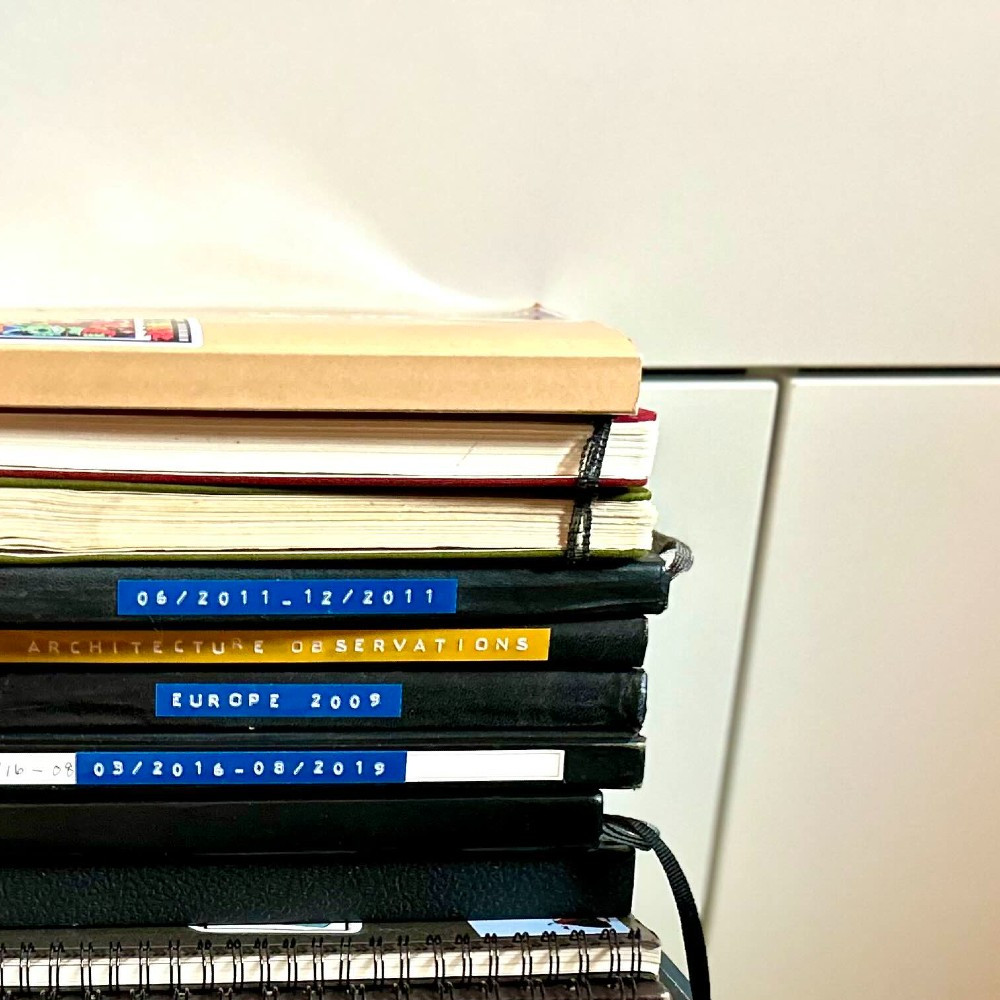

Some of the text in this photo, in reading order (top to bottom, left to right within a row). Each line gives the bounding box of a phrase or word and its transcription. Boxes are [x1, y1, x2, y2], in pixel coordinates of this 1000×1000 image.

[27, 636, 530, 655] ARCHITECTURE OBSERVATIONS
[171, 692, 382, 710] EUROPE 2009
